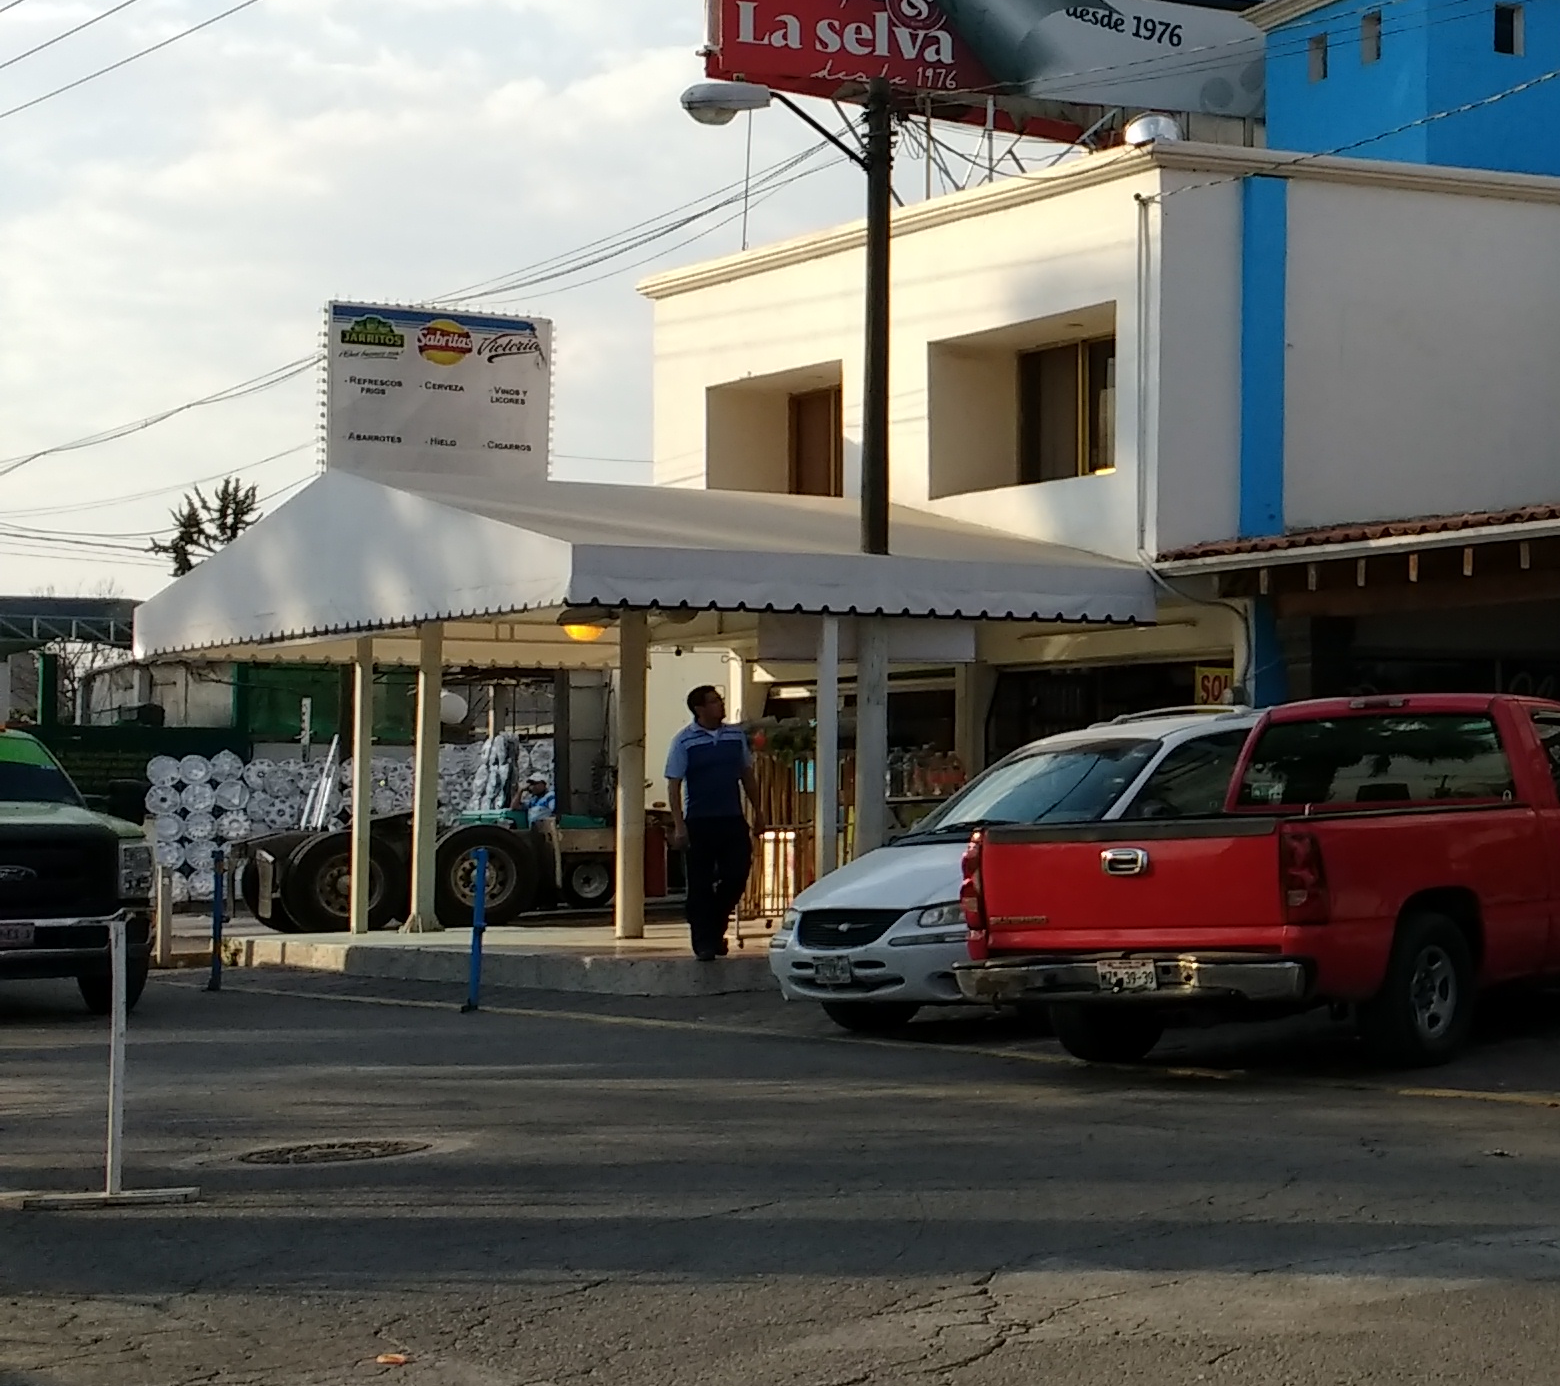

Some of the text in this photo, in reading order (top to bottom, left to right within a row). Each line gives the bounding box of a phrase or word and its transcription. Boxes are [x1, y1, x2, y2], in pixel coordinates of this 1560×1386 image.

[736, 0, 955, 64] La selva
[1132, 15, 1183, 48] 1976
[916, 66, 957, 88] 1976
[344, 333, 402, 346] JARRITOS
[416, 330, 473, 349] Sabritas
[477, 334, 541, 356] Victoria
